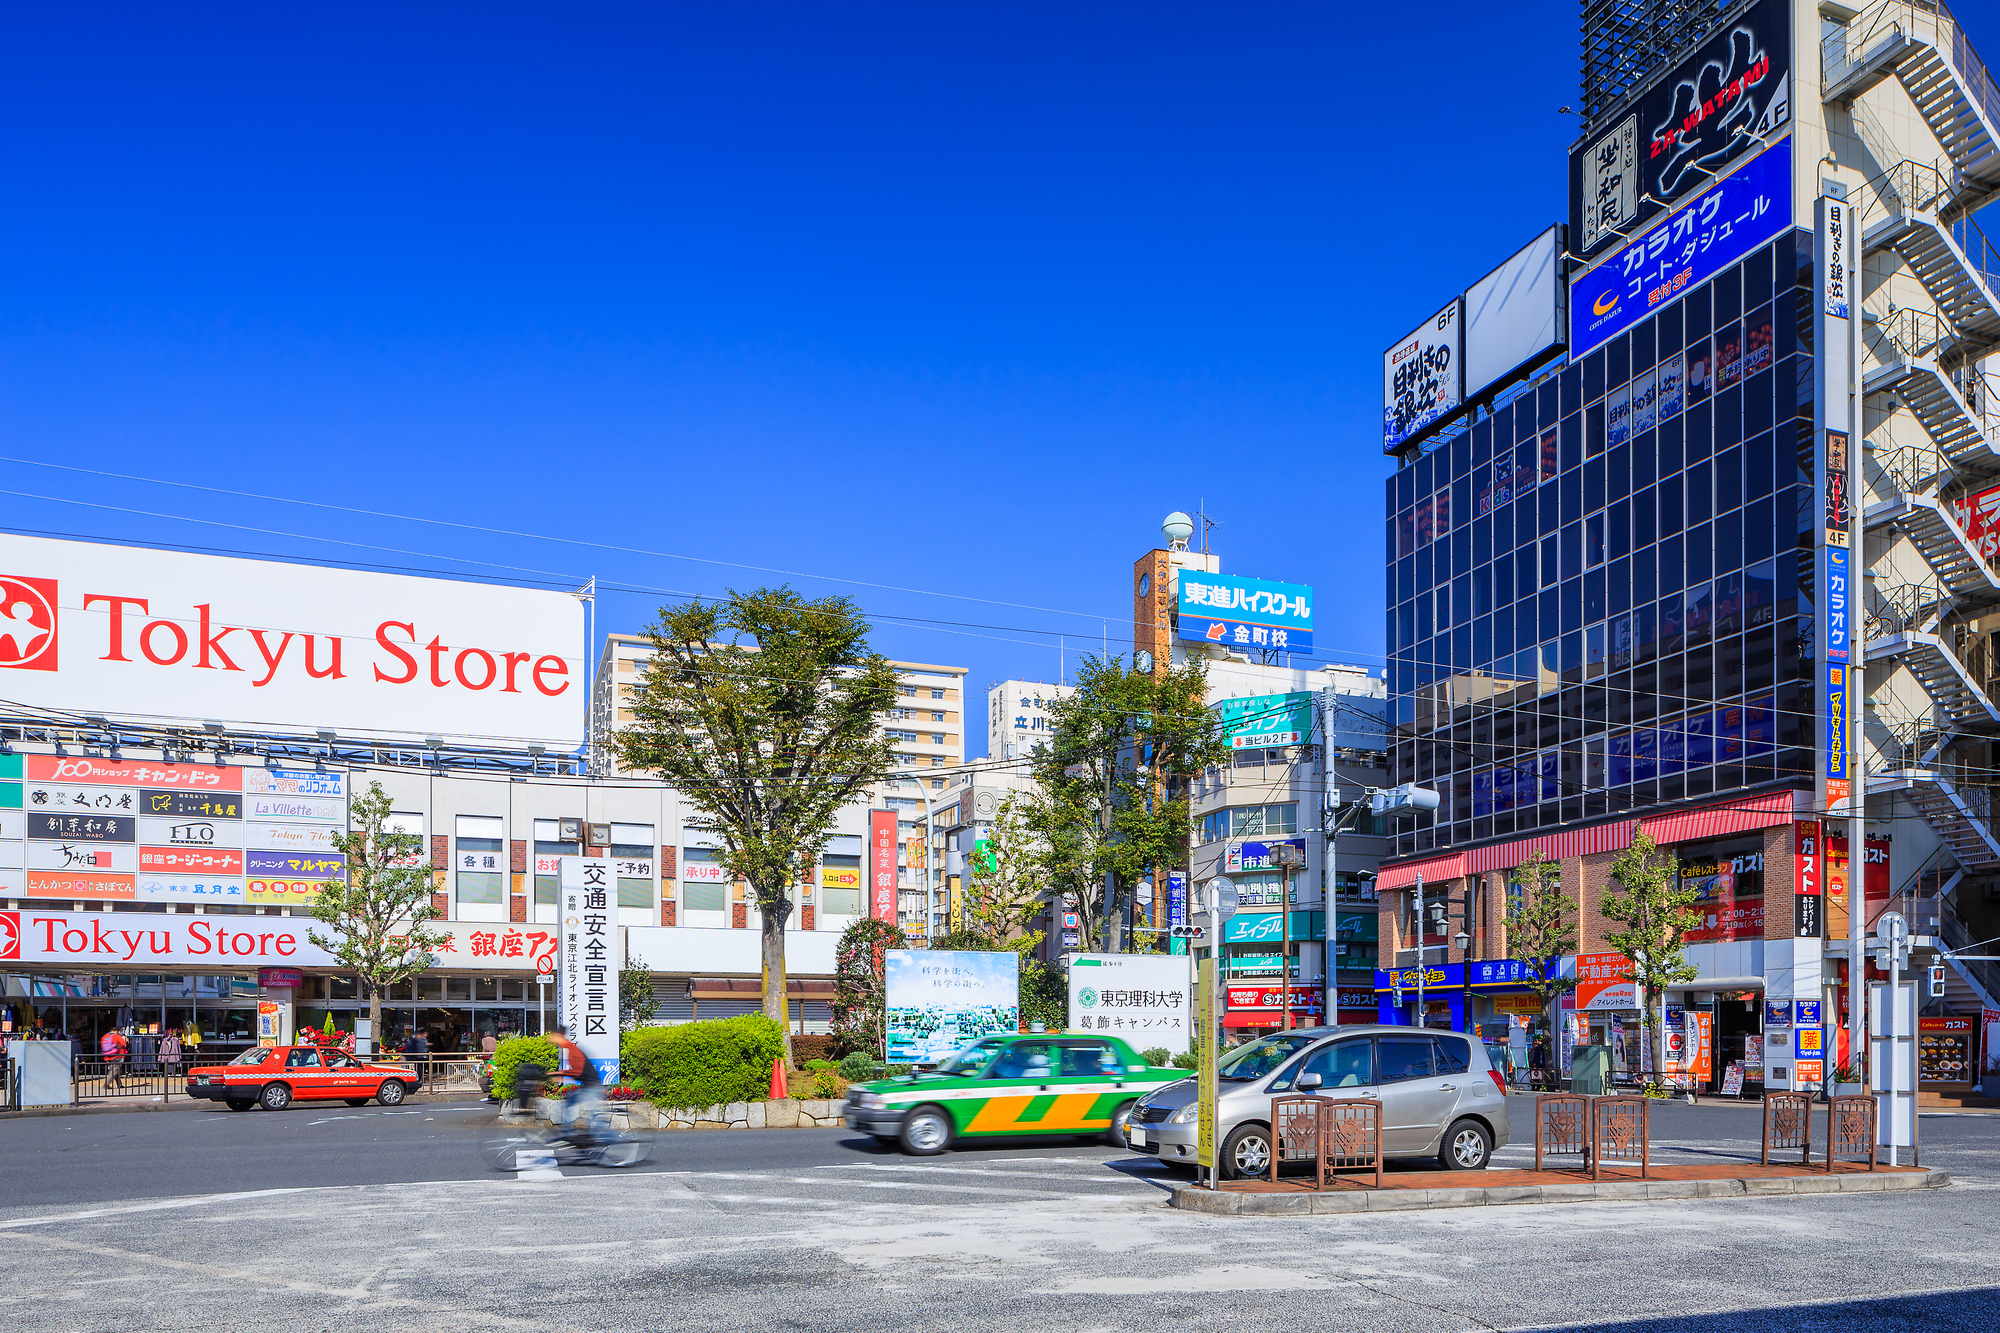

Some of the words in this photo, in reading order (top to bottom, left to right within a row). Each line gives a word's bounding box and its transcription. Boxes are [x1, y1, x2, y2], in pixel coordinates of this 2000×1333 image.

[1623, 190, 1724, 277] カラオケ
[1829, 206, 1844, 300] 目利きの銀次
[1648, 266, 1692, 307] 受付3F
[1437, 305, 1456, 332] 6F
[1829, 532, 1845, 545] 4F
[1184, 582, 1310, 619] 東進ハイスクール
[1831, 575, 1845, 645] カラオケ
[1234, 625, 1288, 648] 金町校
[83, 593, 347, 688] Tokyu
[373, 620, 570, 697] Store
[1829, 649, 1848, 658] 受付3F
[1831, 670, 1841, 684] 薬
[1245, 733, 1288, 746] 当ビル2F
[1616, 718, 1704, 754] カラオケ
[1830, 692, 1842, 772] マツモトキヨシ
[51, 760, 130, 780] 100円ショップ
[275, 779, 341, 794] ママのリフォーム
[200, 802, 236, 816] 千鳥屋
[255, 802, 268, 813] La
[273, 803, 312, 816] Villette
[169, 825, 214, 841] FLO
[1801, 822, 1815, 830] Café
[269, 829, 303, 840] Tokyu
[879, 828, 890, 868] 中国名菜
[250, 860, 284, 868] クリーニング
[288, 859, 342, 872] マルヤマ
[464, 855, 495, 868] 各種
[1802, 837, 1814, 892] ガスト
[686, 866, 720, 879] 承り中
[28, 880, 72, 889] とんかつ
[95, 881, 135, 892] さぼてん
[567, 895, 576, 910] 寄贈
[1230, 915, 1283, 939] エイブル
[33, 918, 172, 960] Tokyu
[187, 921, 297, 956] Store
[583, 862, 607, 1036] 交通安全宣言区
[922, 966, 974, 976] 科学を街へ、
[567, 933, 579, 1046] 東京江北ライオンズクラ
[933, 979, 985, 988] 科学の街へ。
[1100, 989, 1183, 1008] 東京理科大学
[1514, 997, 1528, 1007] Tax
[1529, 996, 1541, 1007] Fre
[1080, 1015, 1181, 1030] 葛飾キャンパス
[1945, 1020, 1968, 1028] ガスト
[1804, 1030, 1818, 1048] 薬
